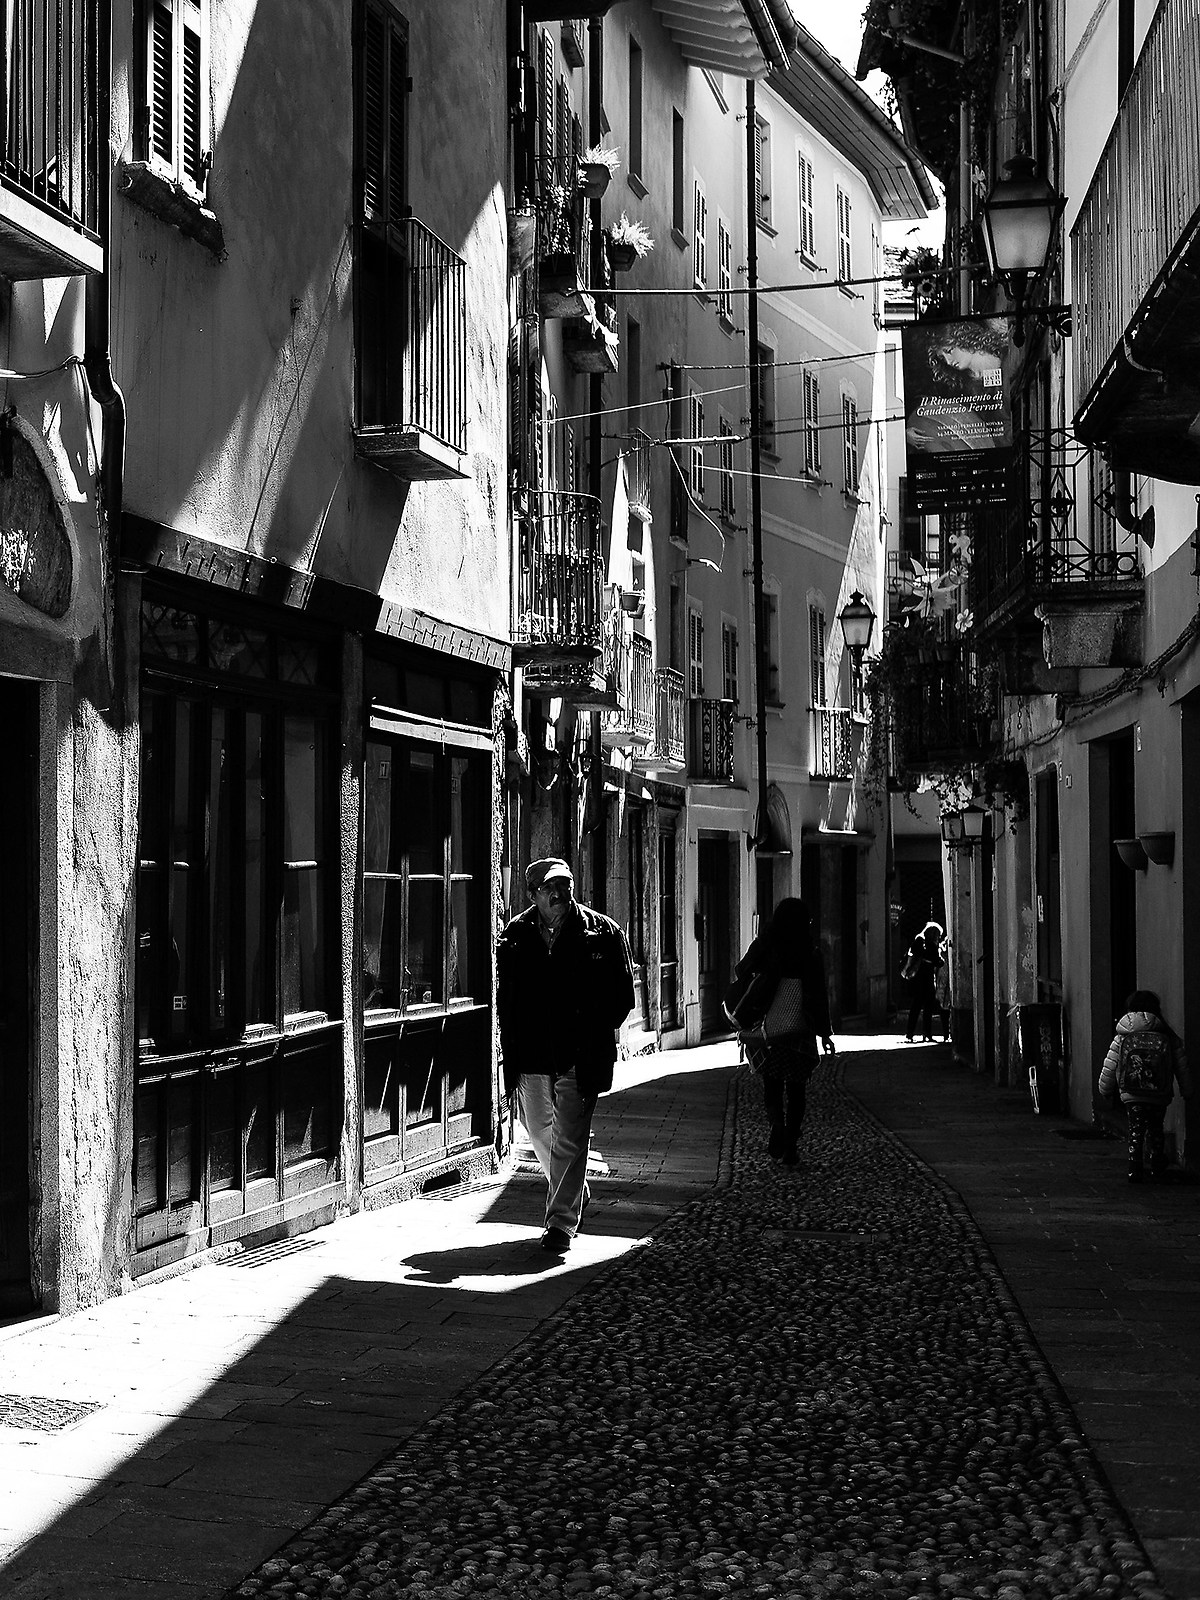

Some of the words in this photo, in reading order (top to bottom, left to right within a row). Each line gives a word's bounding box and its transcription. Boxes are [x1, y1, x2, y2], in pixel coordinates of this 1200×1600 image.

[920, 396, 929, 407] Il
[929, 393, 992, 406] Rinascimento
[993, 391, 1003, 400] di
[916, 404, 967, 417] Gaudenzio
[968, 400, 1004, 413] Ferrari
